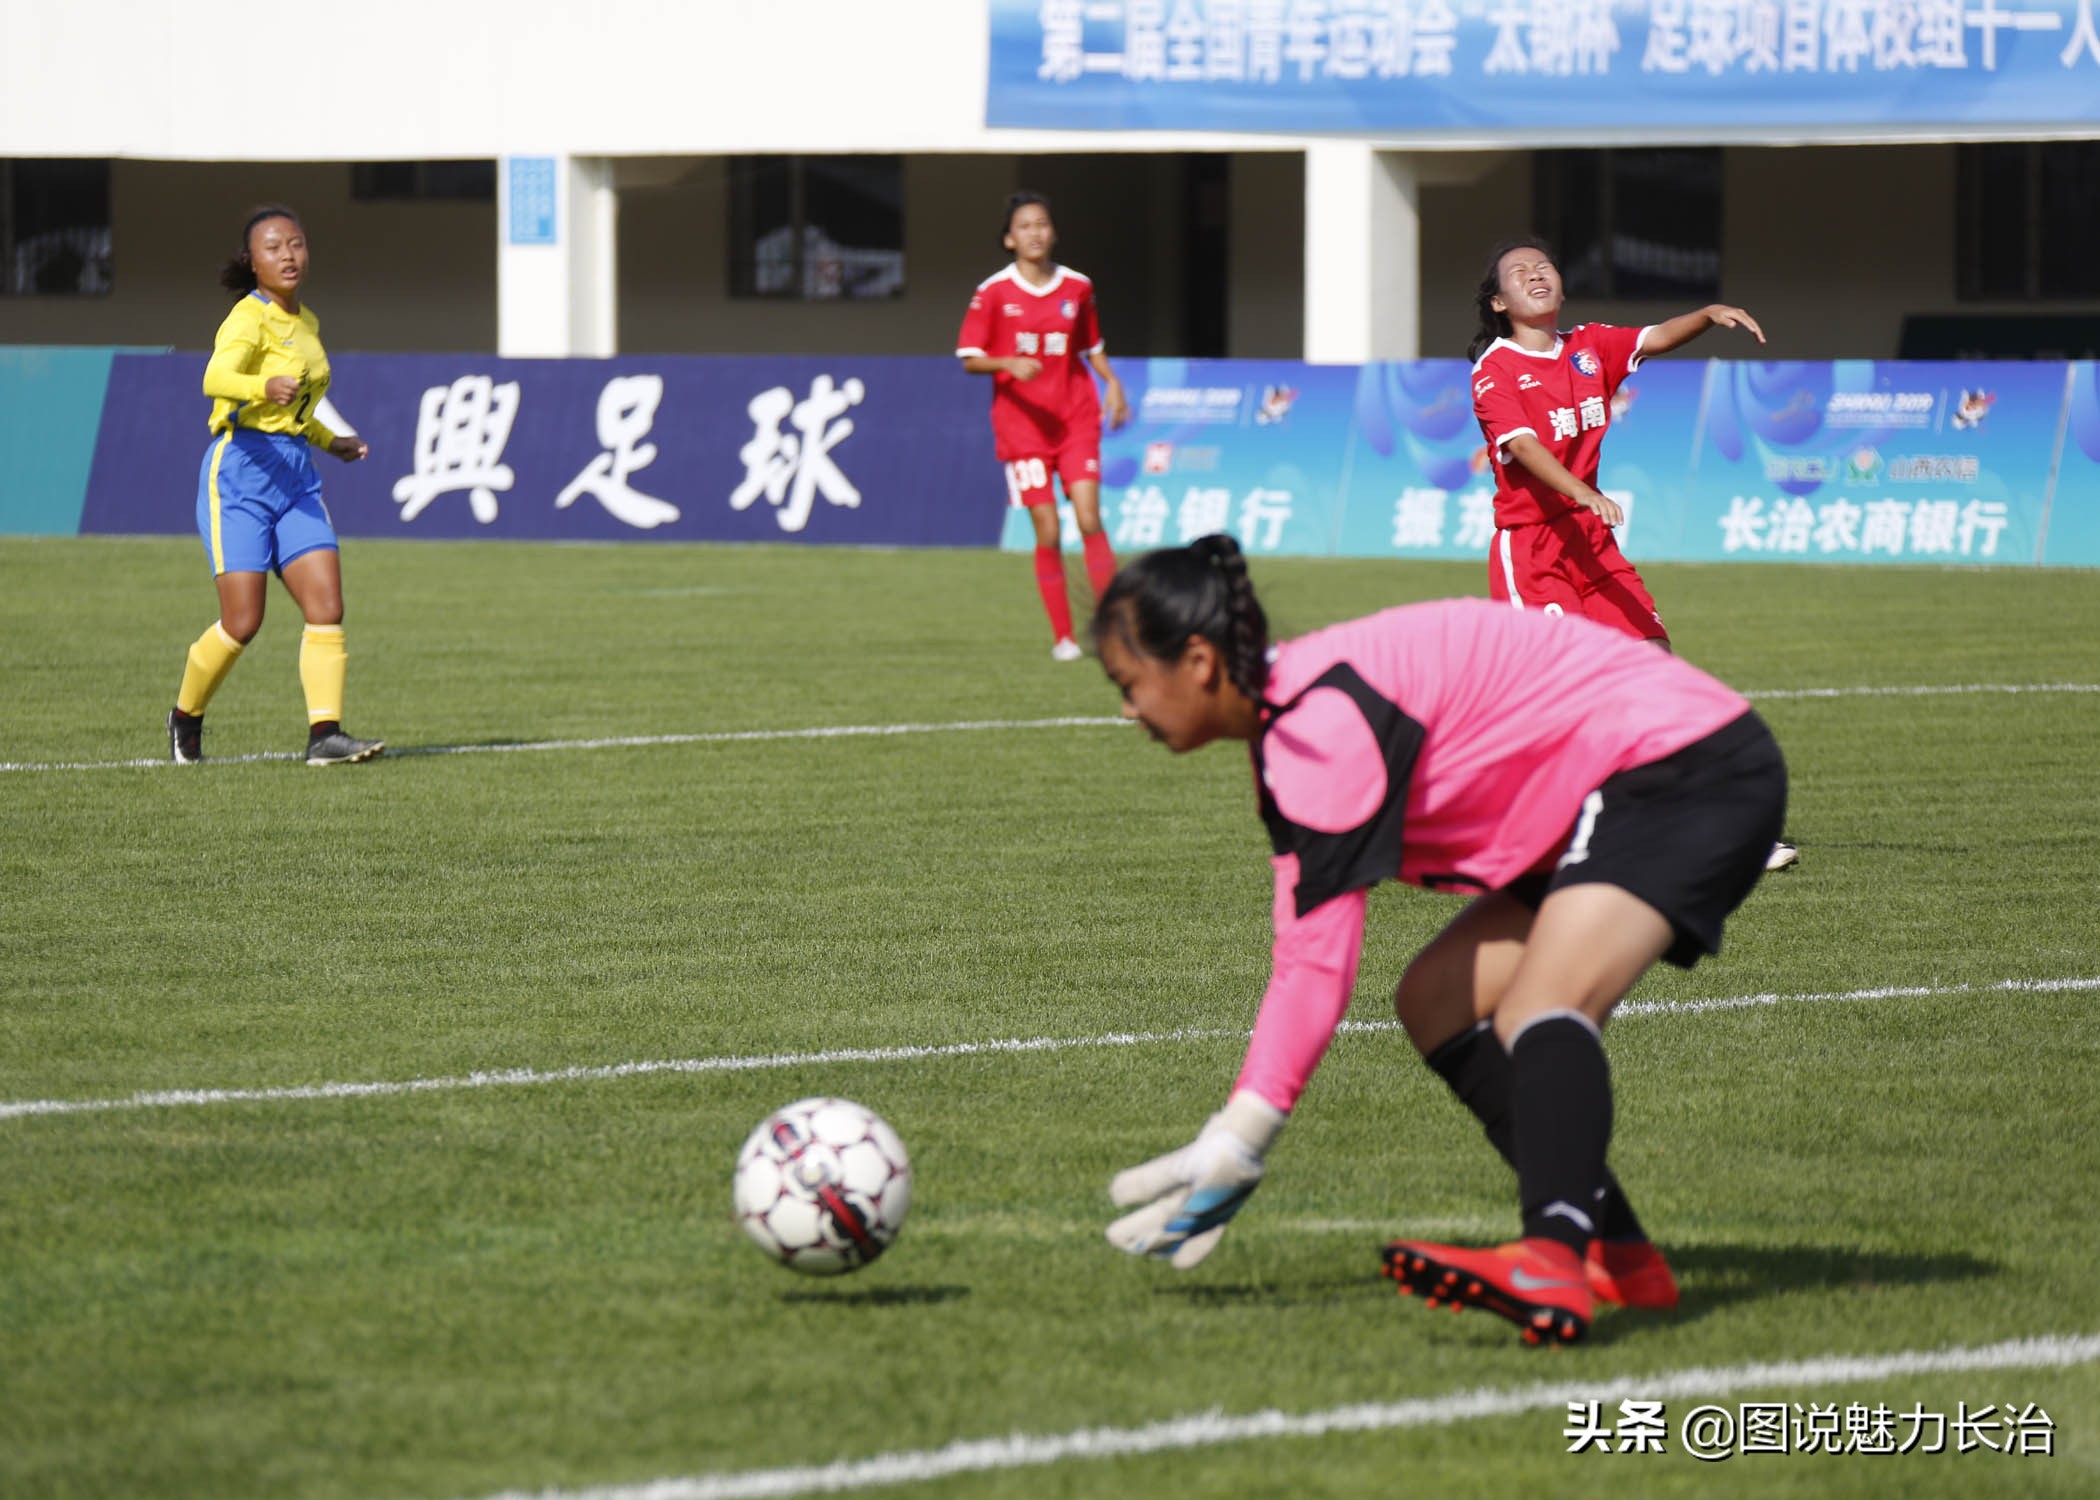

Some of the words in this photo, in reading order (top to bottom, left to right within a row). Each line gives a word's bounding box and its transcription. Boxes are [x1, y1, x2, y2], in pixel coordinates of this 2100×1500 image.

[295, 391, 312, 425] 2
[1547, 395, 1607, 442] 海南
[308, 374, 866, 532] 興足球
[1719, 496, 2008, 556] 长治农商银行
[1557, 789, 1605, 871] 1
